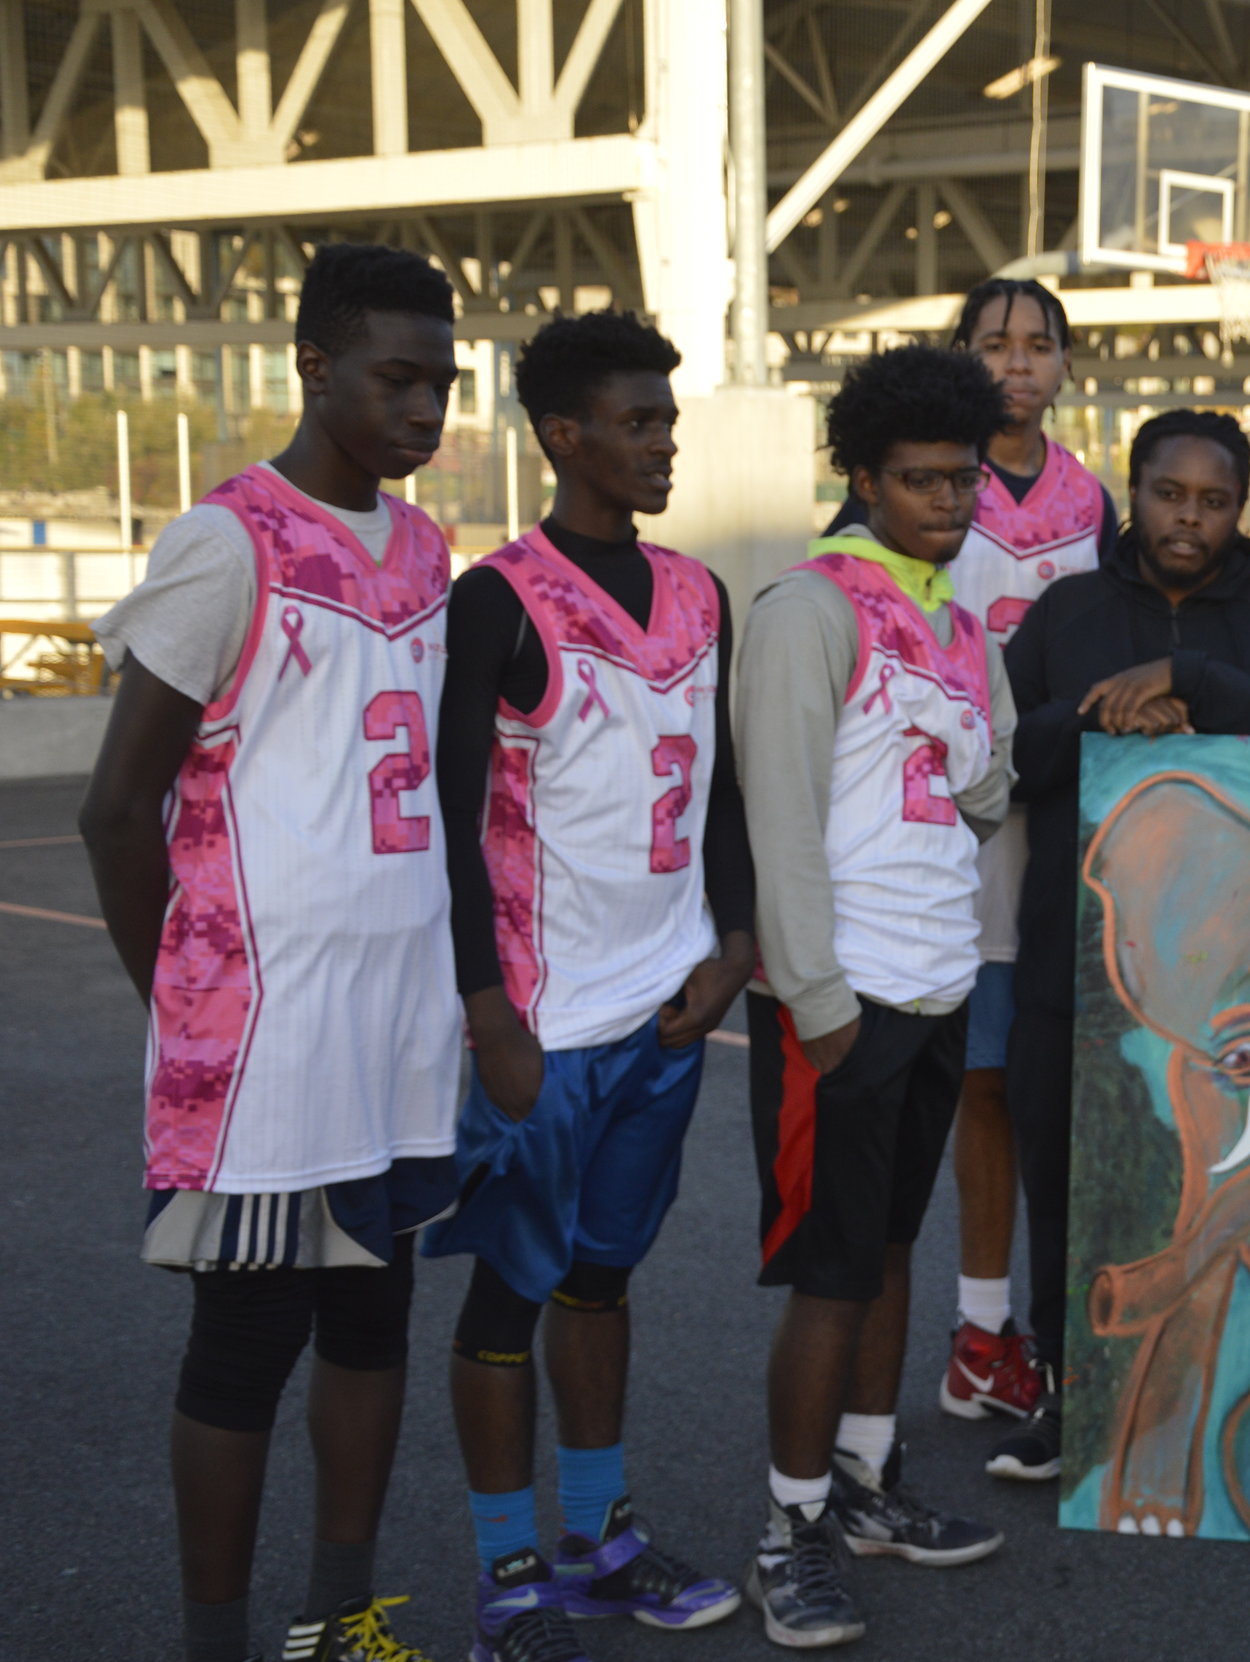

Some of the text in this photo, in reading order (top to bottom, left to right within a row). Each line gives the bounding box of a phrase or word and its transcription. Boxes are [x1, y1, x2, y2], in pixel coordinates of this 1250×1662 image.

[363, 690, 431, 854] 2
[650, 734, 698, 873] 2
[902, 725, 957, 826] 2
